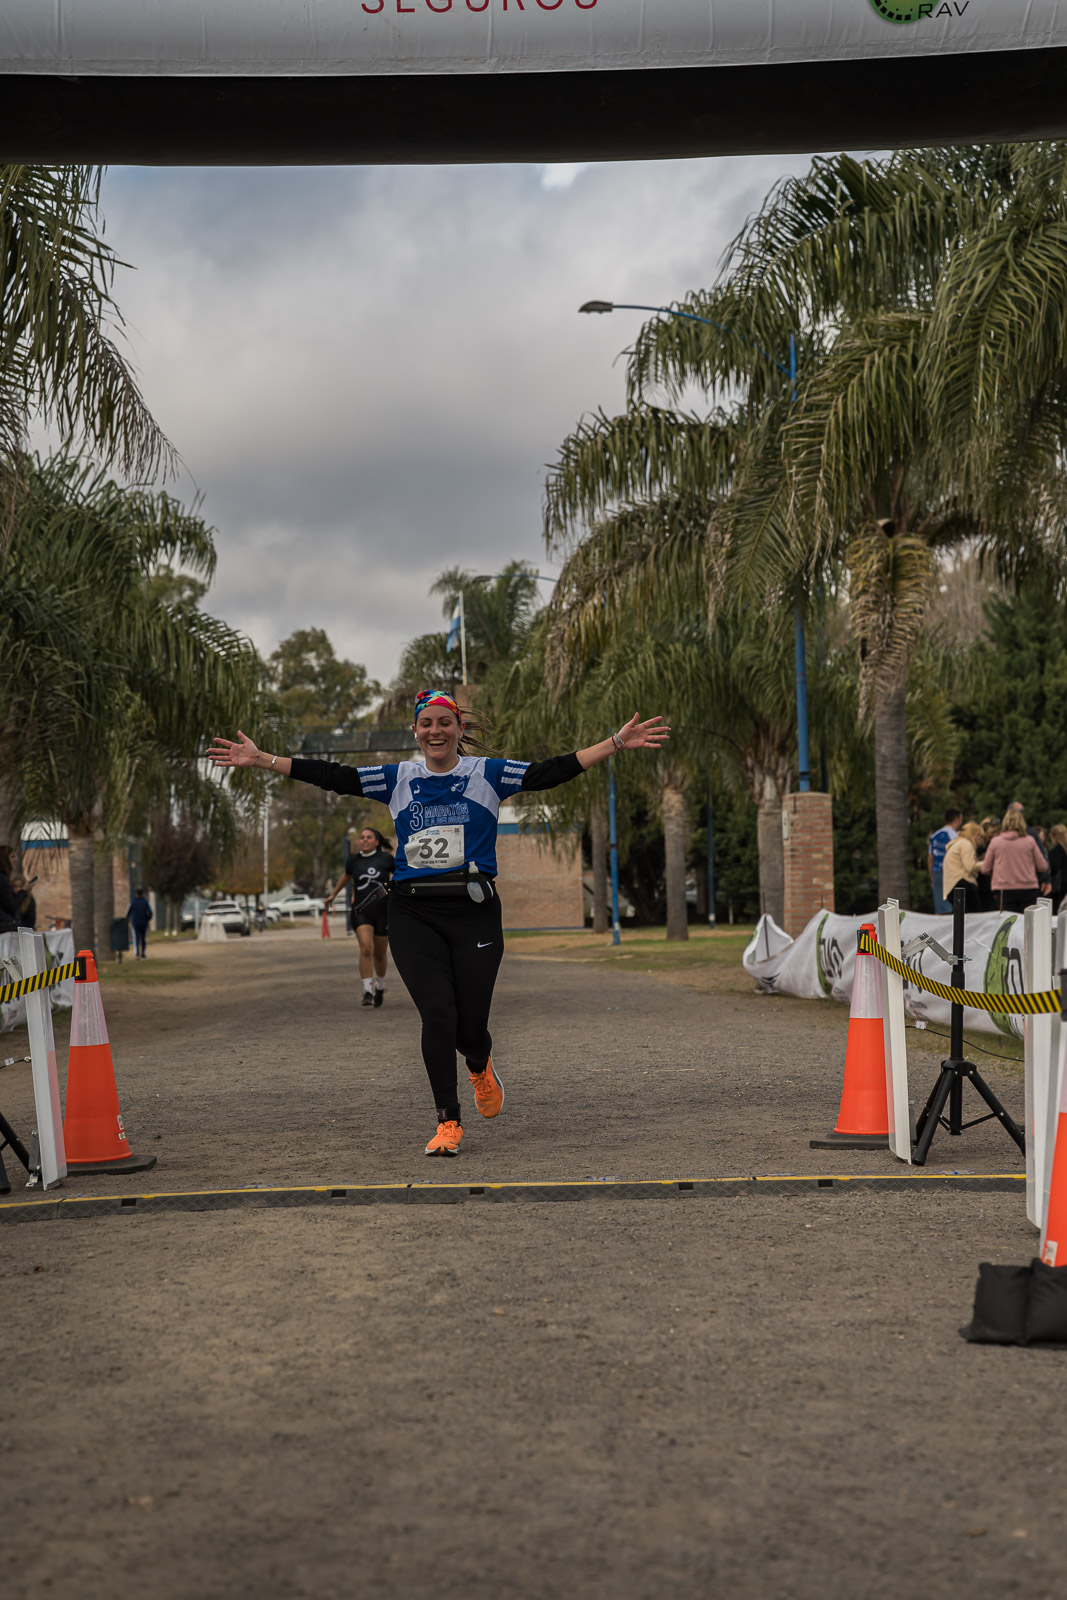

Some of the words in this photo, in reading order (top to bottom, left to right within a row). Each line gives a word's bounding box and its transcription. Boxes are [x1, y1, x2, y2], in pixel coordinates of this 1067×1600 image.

[918, 1, 970, 19] RAV
[409, 800, 424, 831] 3
[418, 837, 450, 859] 32
